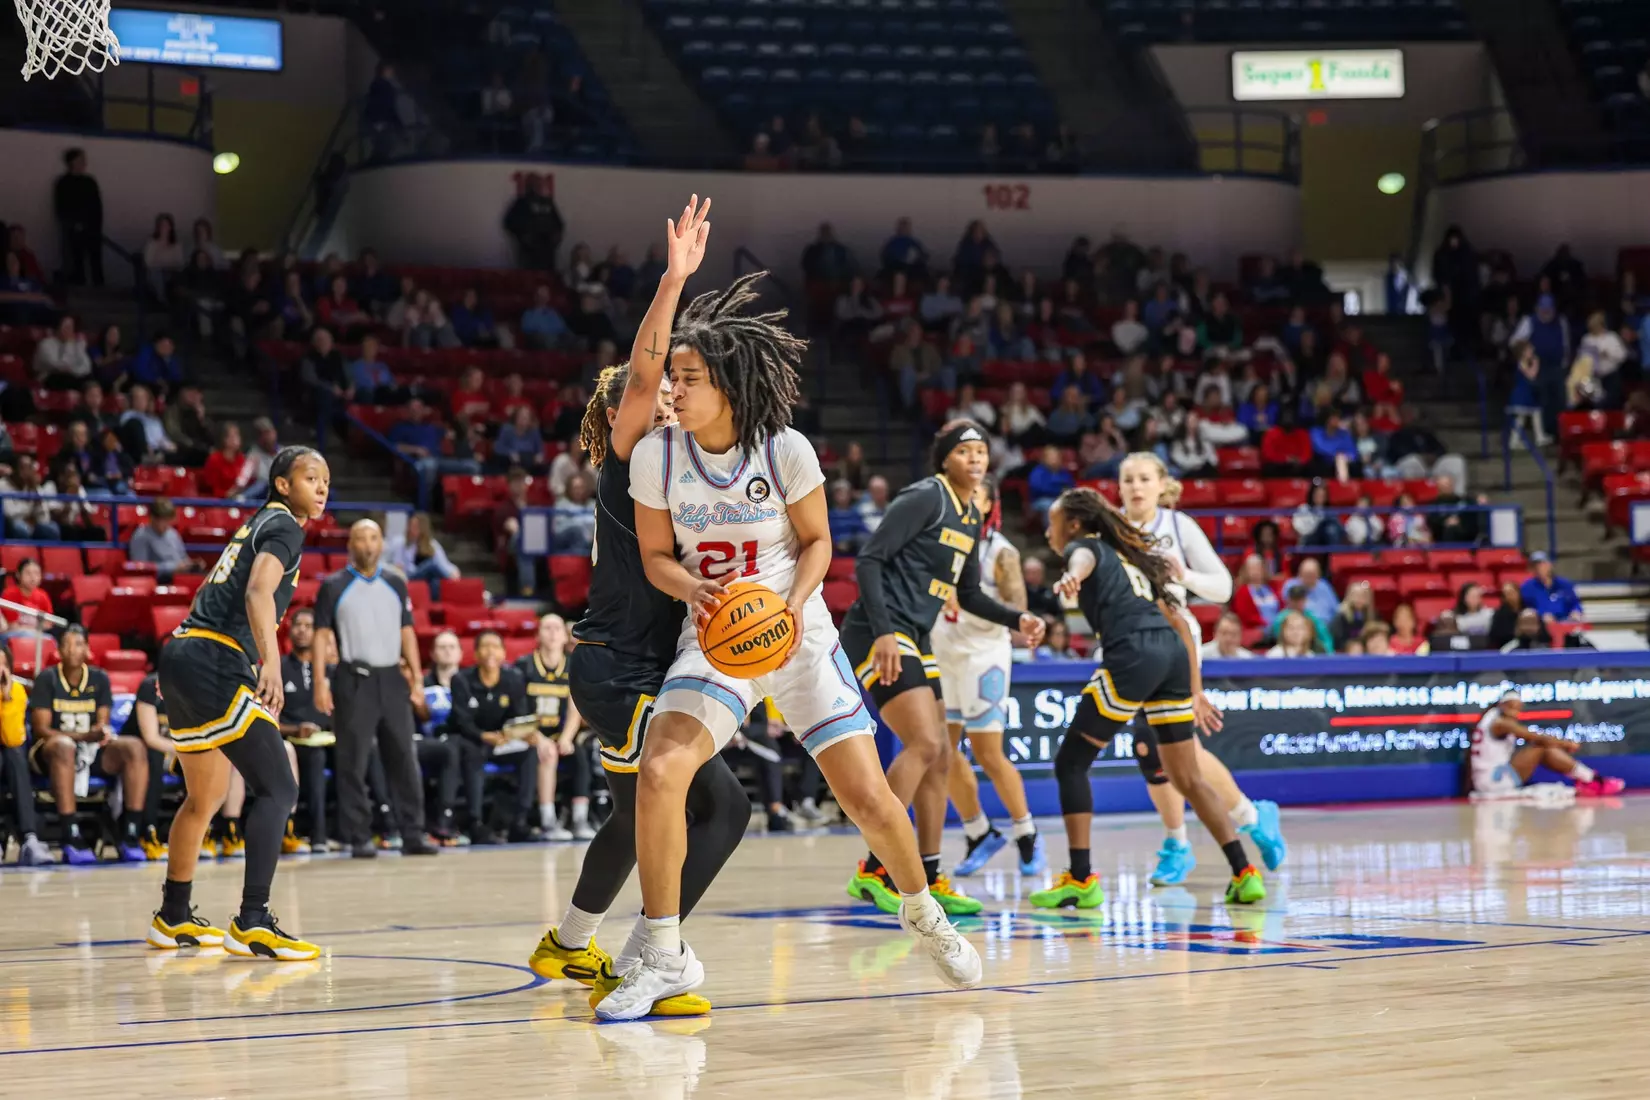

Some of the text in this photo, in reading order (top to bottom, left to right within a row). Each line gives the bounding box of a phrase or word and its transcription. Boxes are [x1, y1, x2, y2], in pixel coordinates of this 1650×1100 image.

[1243, 62, 1303, 85] Super
[982, 184, 1031, 210] 102
[673, 501, 778, 533] Lady Techsters
[696, 540, 760, 579] 21
[729, 618, 790, 656] Wilson
